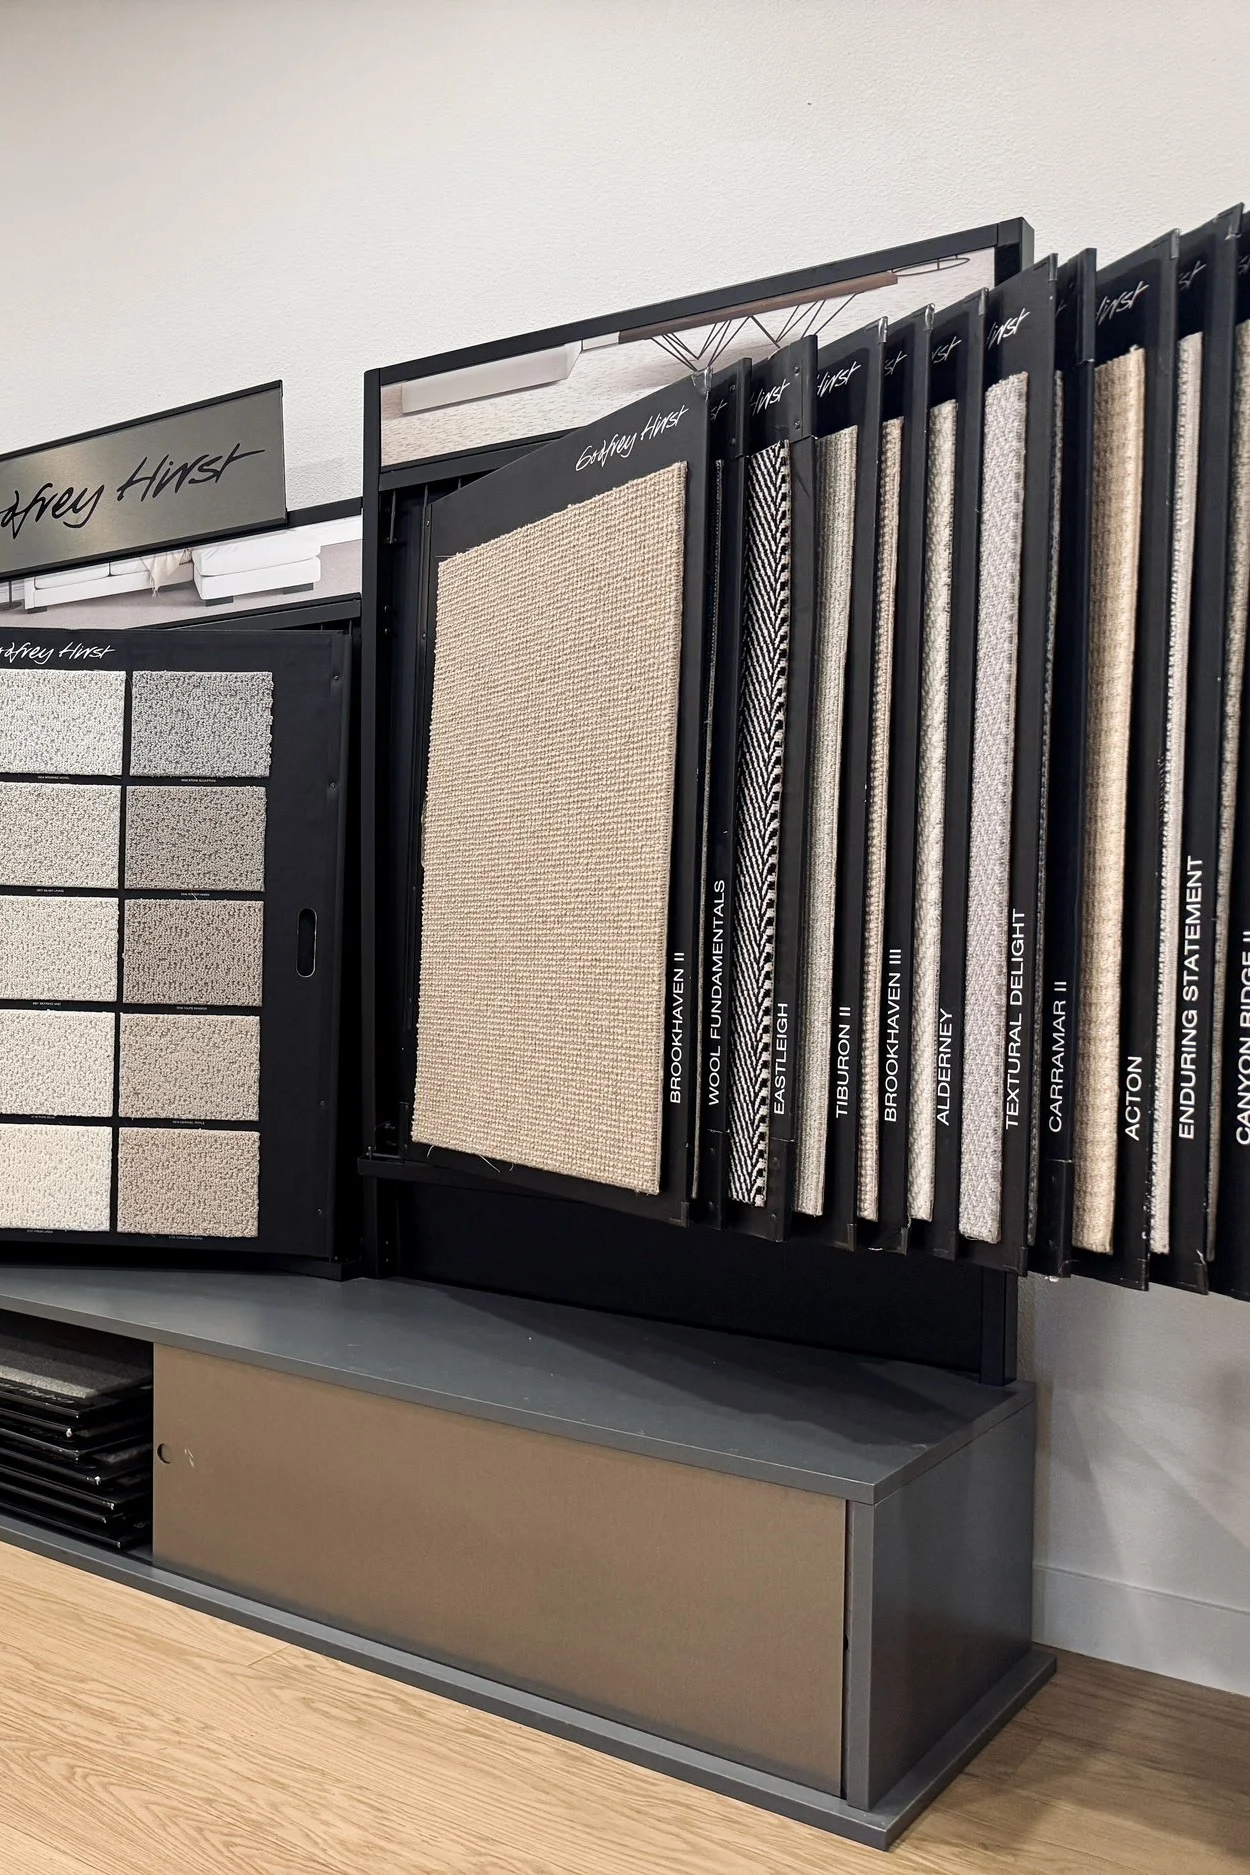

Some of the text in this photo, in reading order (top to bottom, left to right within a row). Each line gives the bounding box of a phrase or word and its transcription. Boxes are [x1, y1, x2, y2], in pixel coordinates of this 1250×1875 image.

[117, 443, 266, 502] Hirst
[575, 433, 636, 472] Godfrey
[640, 405, 690, 441] Hirst
[58, 641, 116, 660] Hirst
[670, 952, 685, 1104] BROOKHAVEN II
[708, 880, 725, 1106] WOOL FUNDAMENTALS
[885, 949, 902, 1122] BROOKHAVEN III
[1005, 908, 1025, 1130] TEXTURAL DELIGHT
[1179, 856, 1203, 1140] ENDURING STATEMENT
[773, 1003, 788, 1115] EASTLEIGH
[836, 1006, 851, 1118] TIBURON II
[936, 1008, 953, 1126] ALDERNEY
[1049, 981, 1067, 1133] CARRAMAR II
[1124, 1056, 1143, 1141] ACTON
[1235, 1037, 1250, 1146] CANYON
